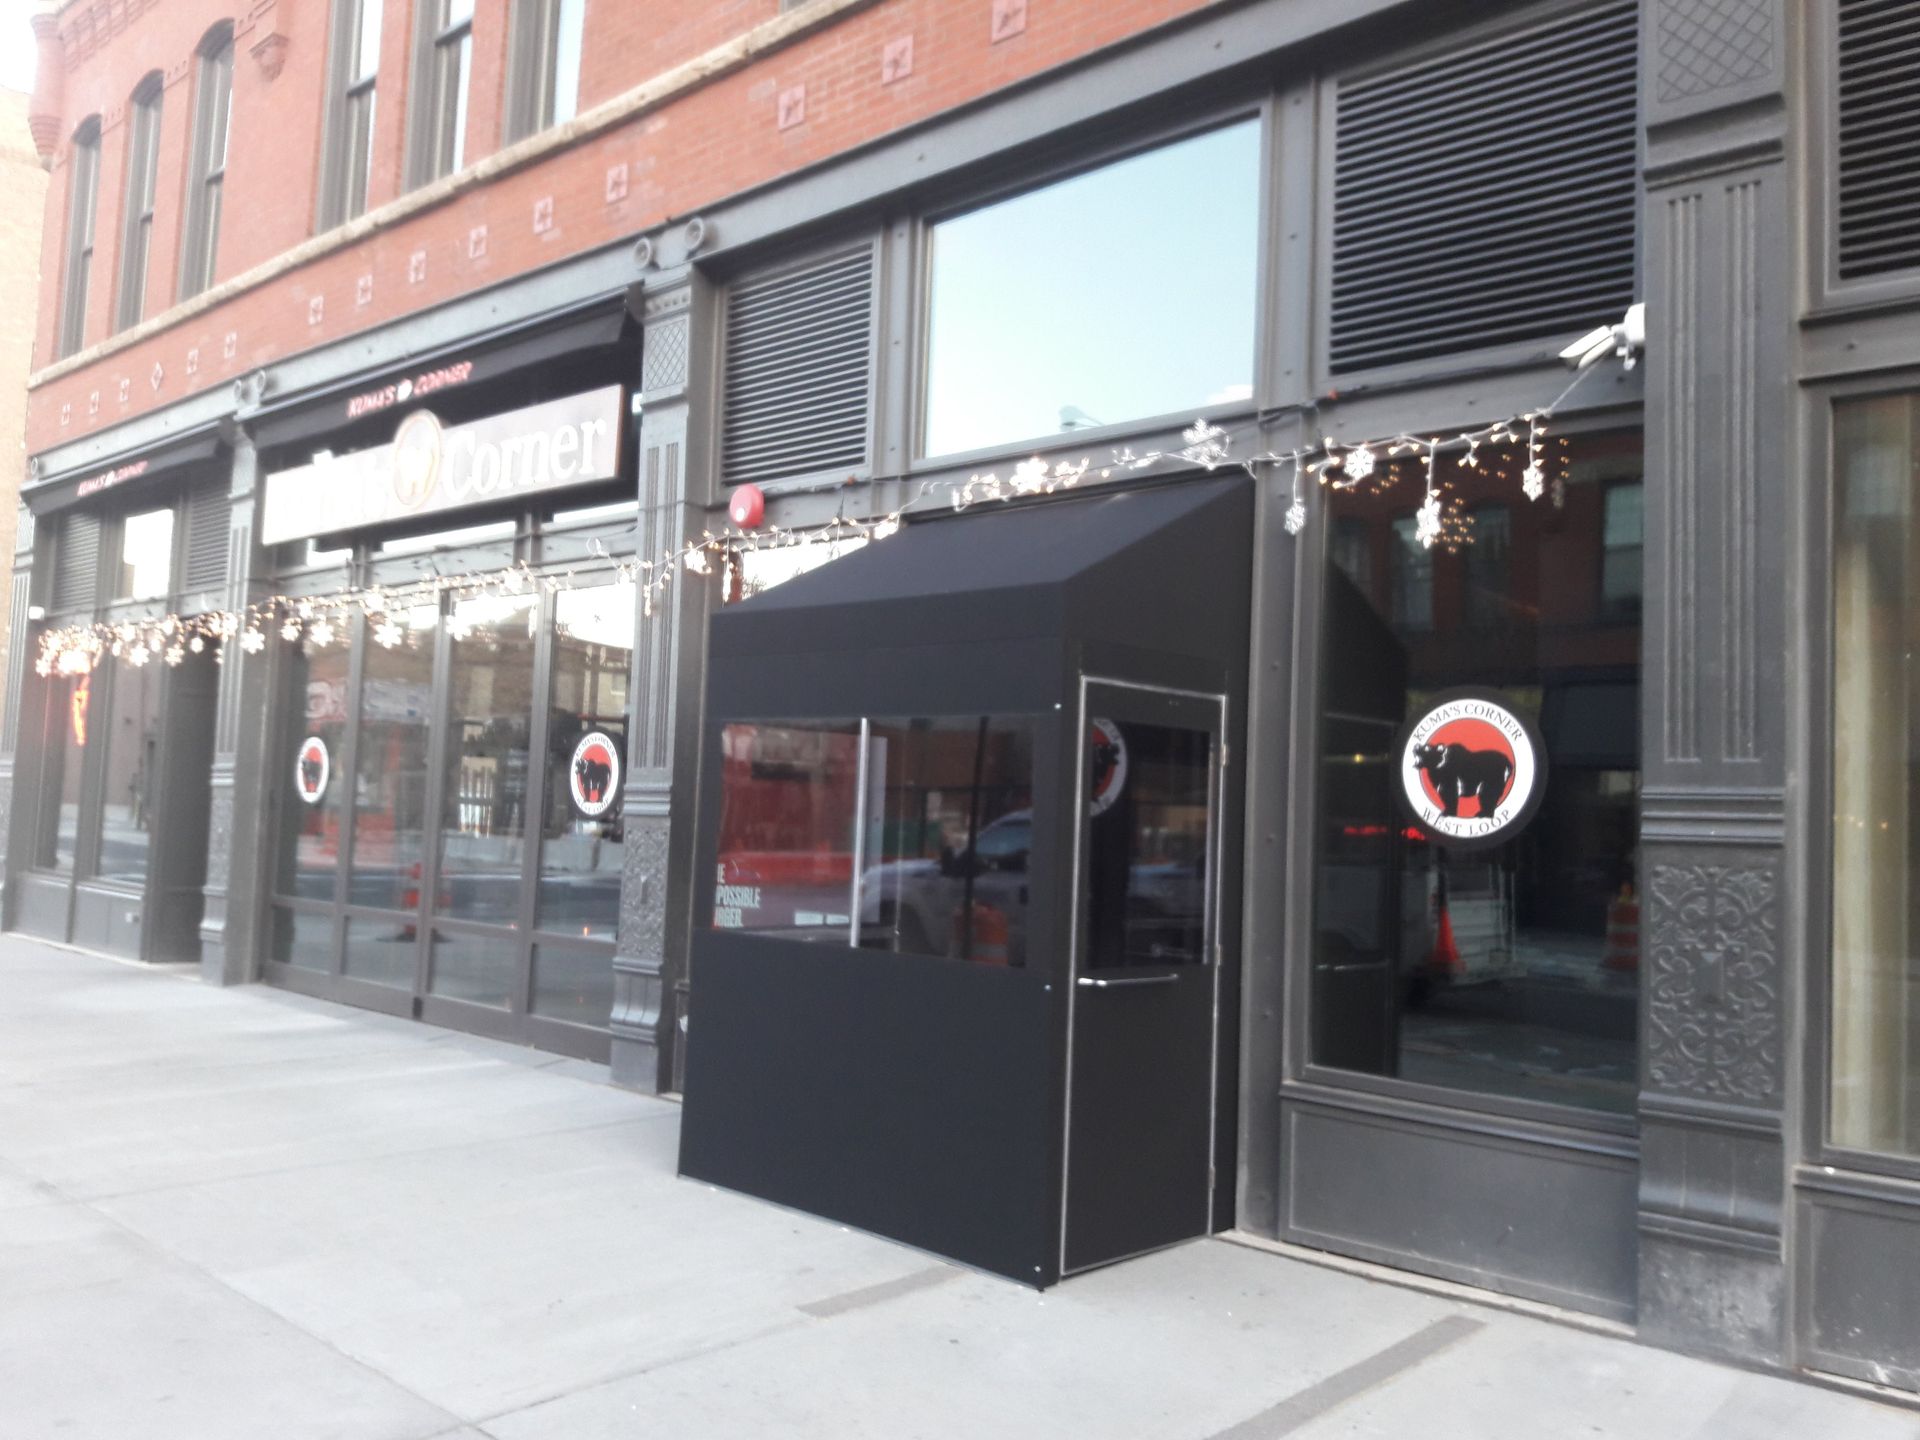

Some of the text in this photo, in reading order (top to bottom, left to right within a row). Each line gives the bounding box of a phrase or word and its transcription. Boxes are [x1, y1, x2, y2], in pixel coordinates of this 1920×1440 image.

[442, 417, 607, 501] Corner
[1414, 703, 1522, 741] KUMA'S CORNER
[1423, 807, 1510, 837] WEST LOOP
[715, 885, 761, 909] POSSIBLE
